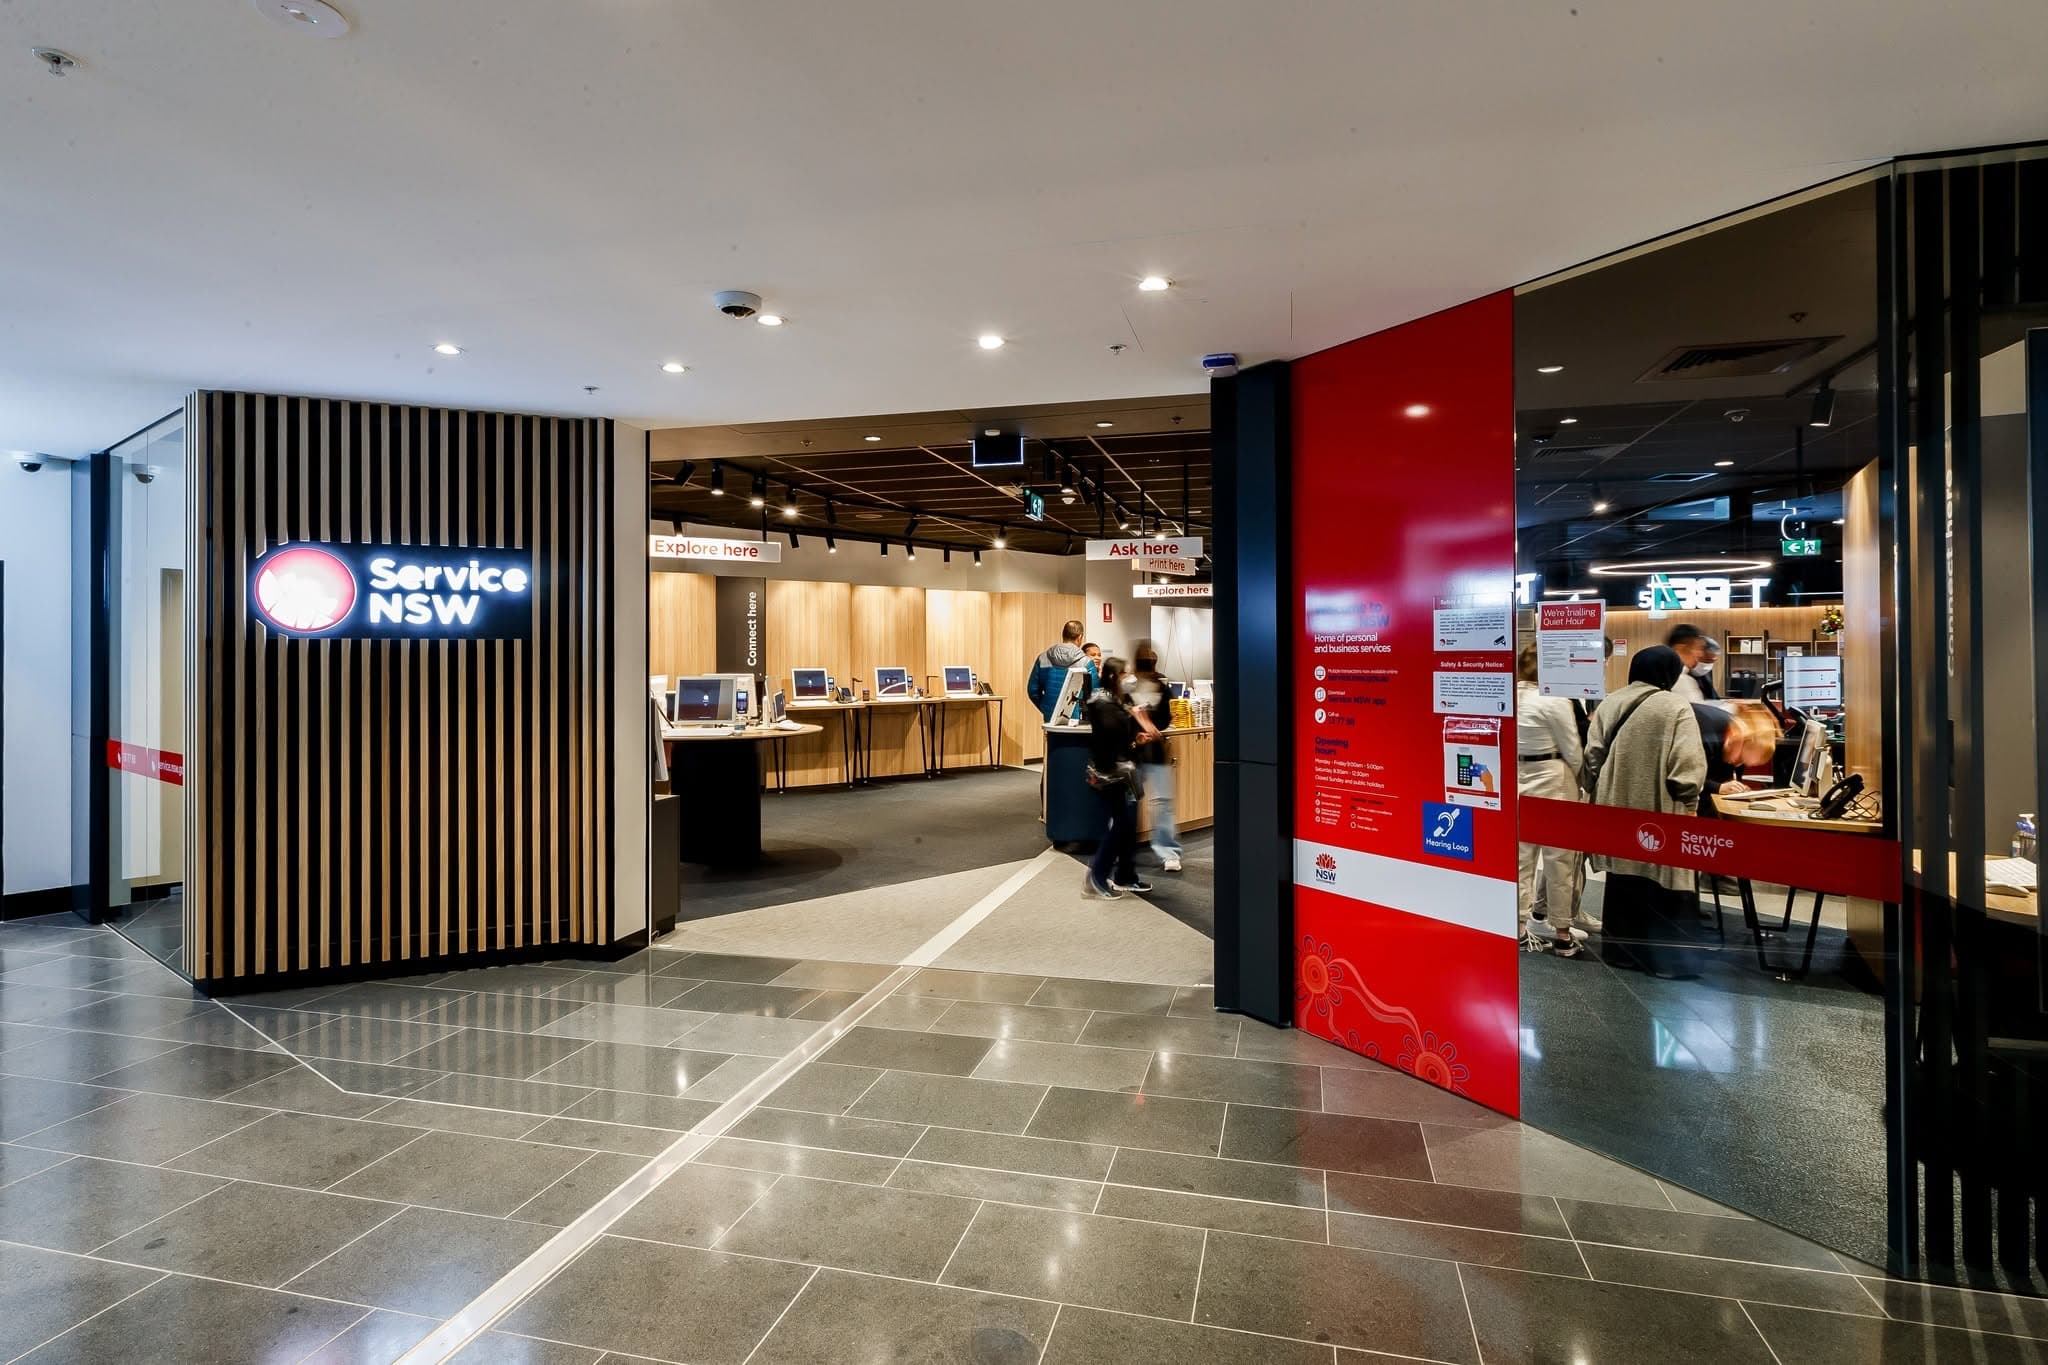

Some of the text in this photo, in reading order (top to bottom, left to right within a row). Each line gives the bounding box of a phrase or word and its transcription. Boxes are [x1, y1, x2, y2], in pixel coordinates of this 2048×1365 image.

[654, 539, 759, 557] Explore here
[1109, 542, 1179, 556] Ask here
[1168, 560, 1186, 571] here
[369, 557, 528, 592] Service
[1146, 586, 1209, 596] Explore here
[369, 592, 481, 625] NSW
[1543, 607, 1565, 617] We're
[1543, 616, 1585, 627] Quiet Hour
[746, 591, 757, 667] Connect here
[1314, 632, 1378, 644] Home of personal
[1314, 643, 1392, 654] and business services
[1440, 661, 1456, 669] Safety
[1462, 661, 1485, 669] Security
[1425, 837, 1470, 853] Hearing Loop
[1681, 830, 1734, 848] Service
[1681, 842, 1717, 858] NSW
[1315, 868, 1337, 881] NSW
